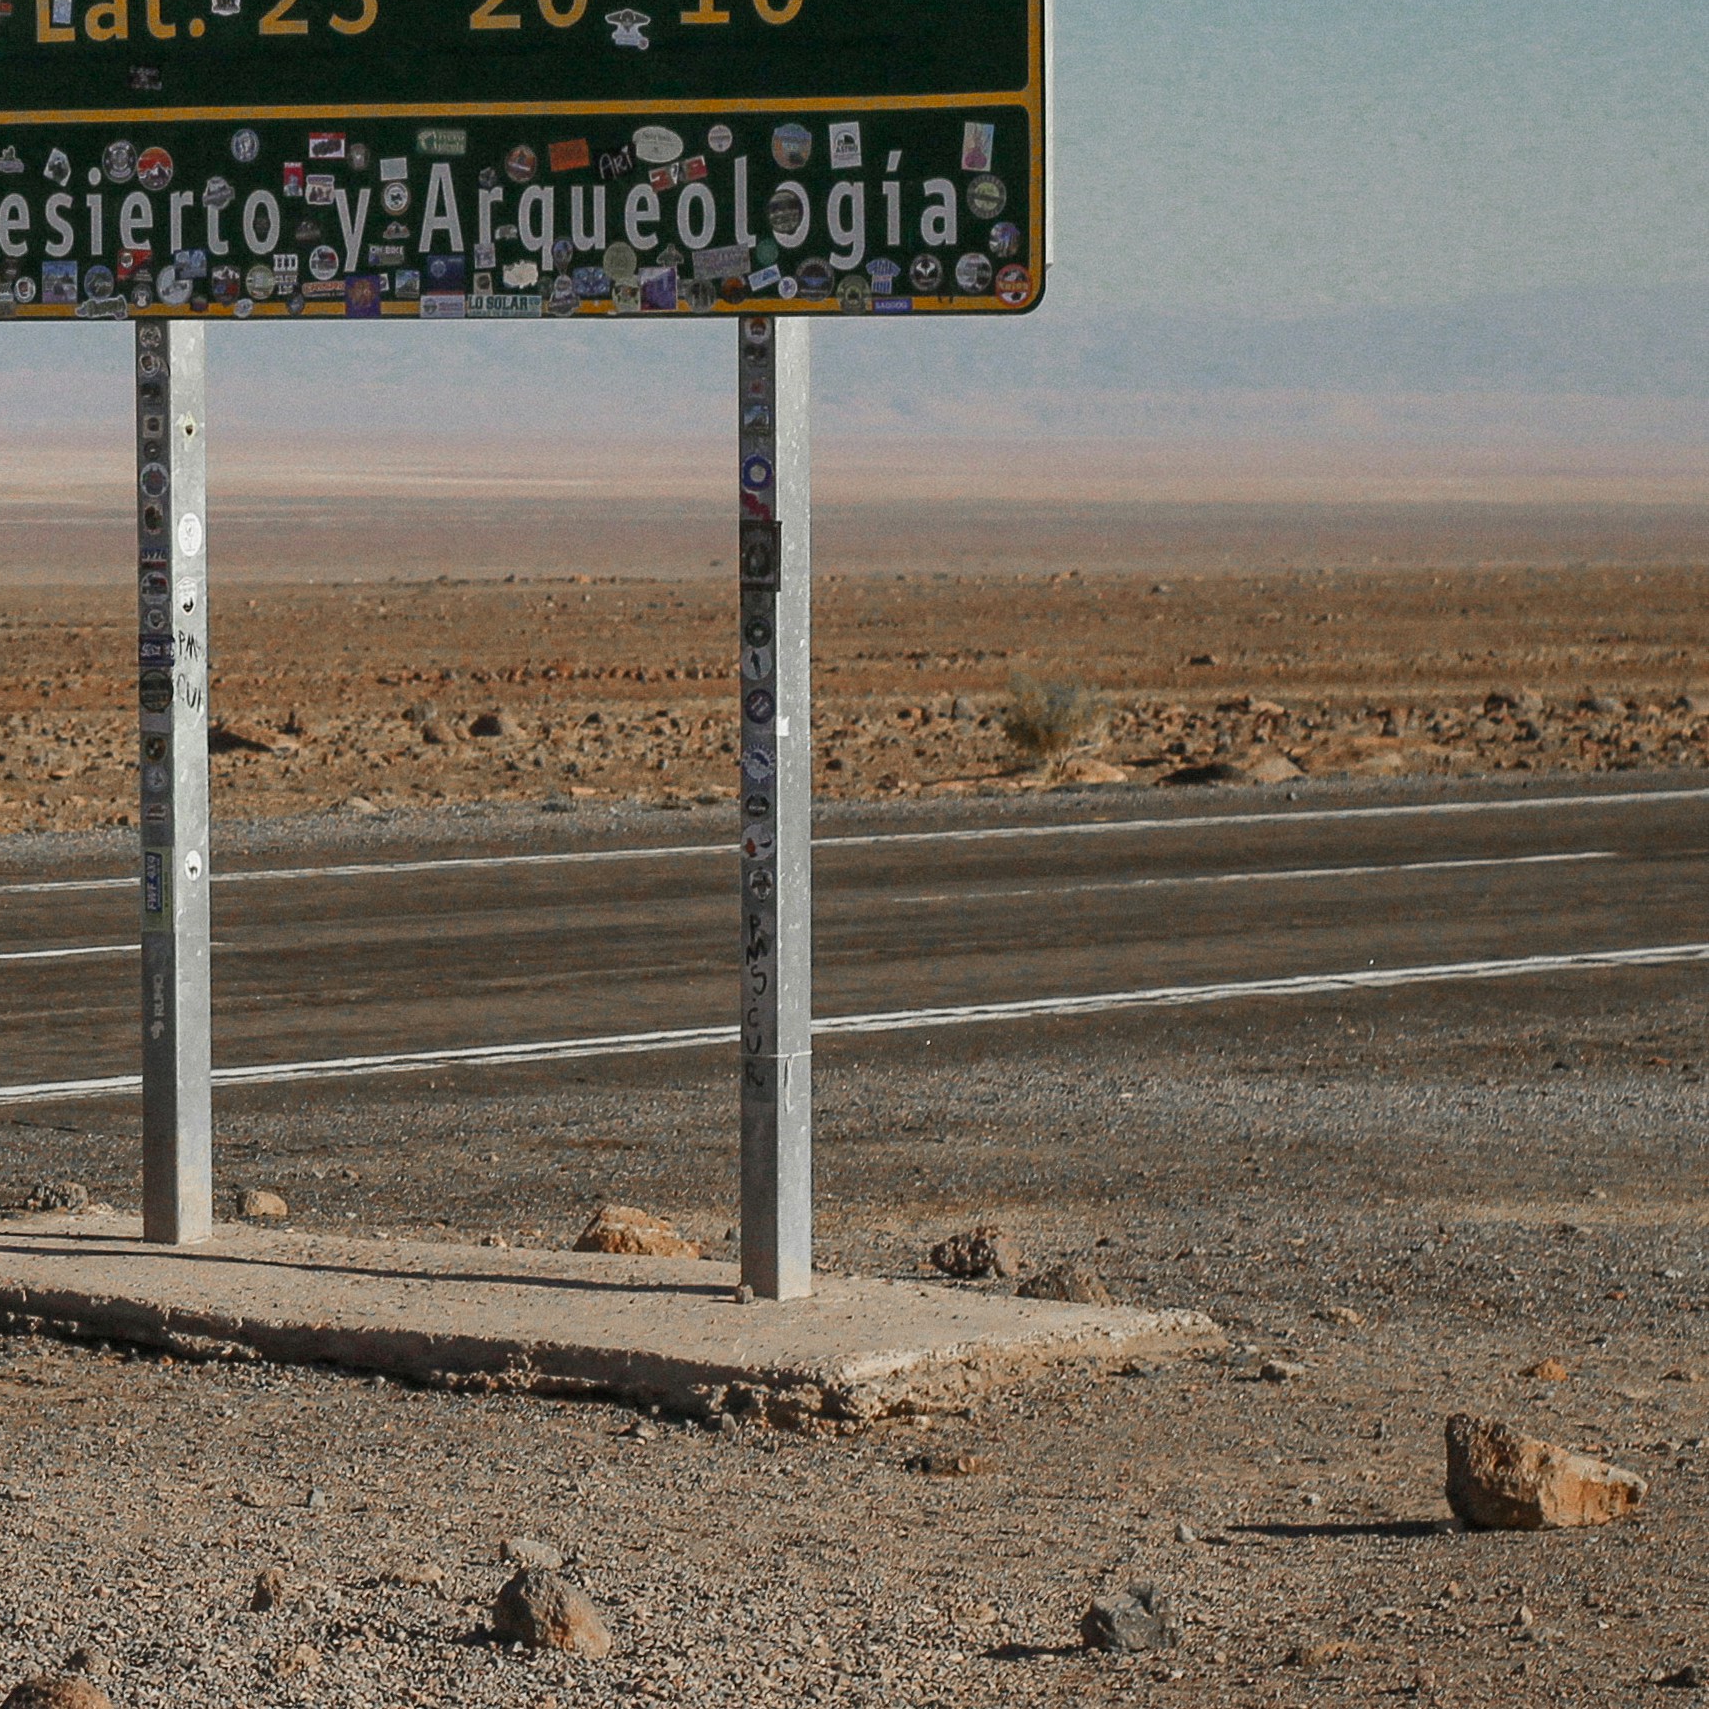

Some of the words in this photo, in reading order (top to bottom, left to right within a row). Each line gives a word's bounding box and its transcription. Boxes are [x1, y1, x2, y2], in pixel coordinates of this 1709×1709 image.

[335, 188, 372, 273] y
[419, 149, 959, 271] Arqueología
[486, 295, 528, 310] SOLAR
